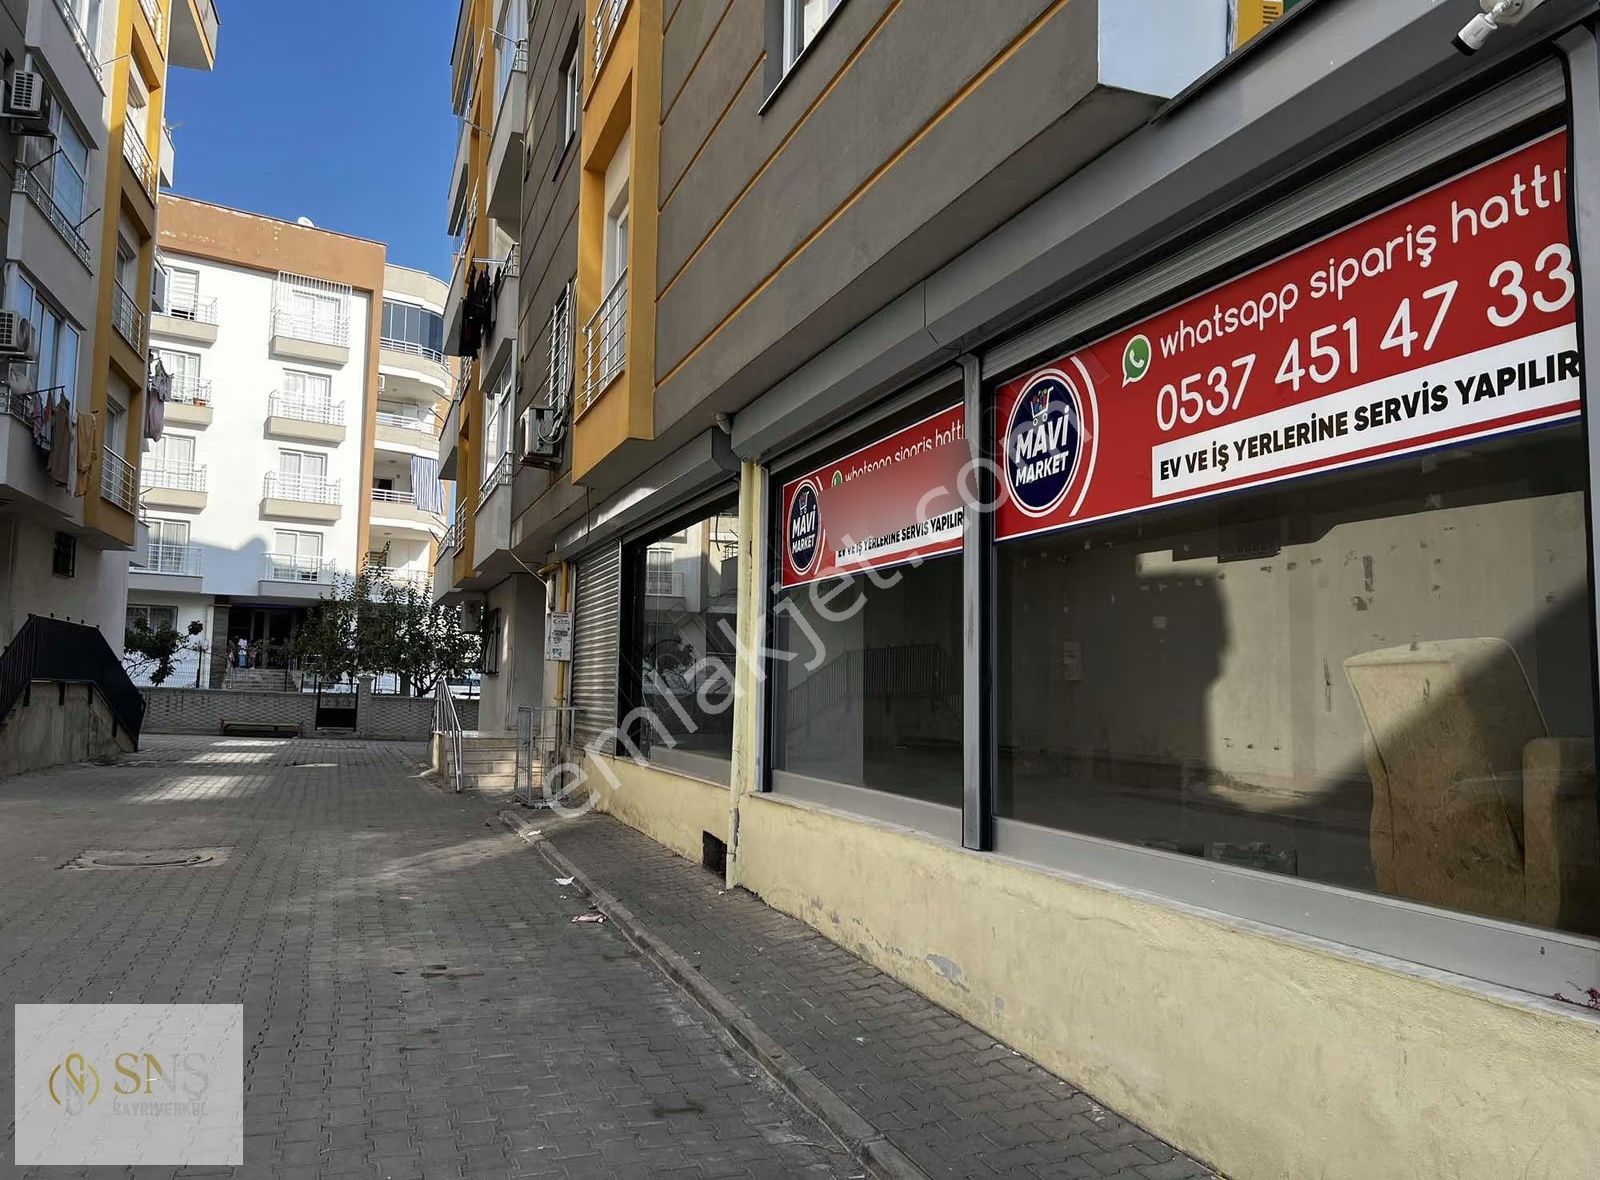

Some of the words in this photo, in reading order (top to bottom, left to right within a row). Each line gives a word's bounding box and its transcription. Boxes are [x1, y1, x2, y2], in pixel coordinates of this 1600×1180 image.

[1160, 283, 1299, 359] whatsapp
[1310, 224, 1437, 301] sipariş
[1452, 164, 1561, 244] hattı
[1156, 353, 1257, 432] 0537
[1274, 317, 1359, 392] 451
[1379, 280, 1459, 358] 47
[1486, 243, 1576, 328] 33
[1015, 405, 1070, 464] MAVİ
[1160, 456, 1182, 481] EV
[1185, 449, 1208, 475] VE
[1212, 440, 1229, 472] İŞ
[1233, 410, 1349, 462] YERLERİNE
[1354, 380, 1449, 432] SERVİS
[1455, 349, 1580, 405] YAPILIR
[1015, 450, 1070, 487] MARKET
[791, 533, 816, 554] MARKET
[792, 503, 816, 539] MAVİ
[930, 511, 965, 533] YAPILIR
